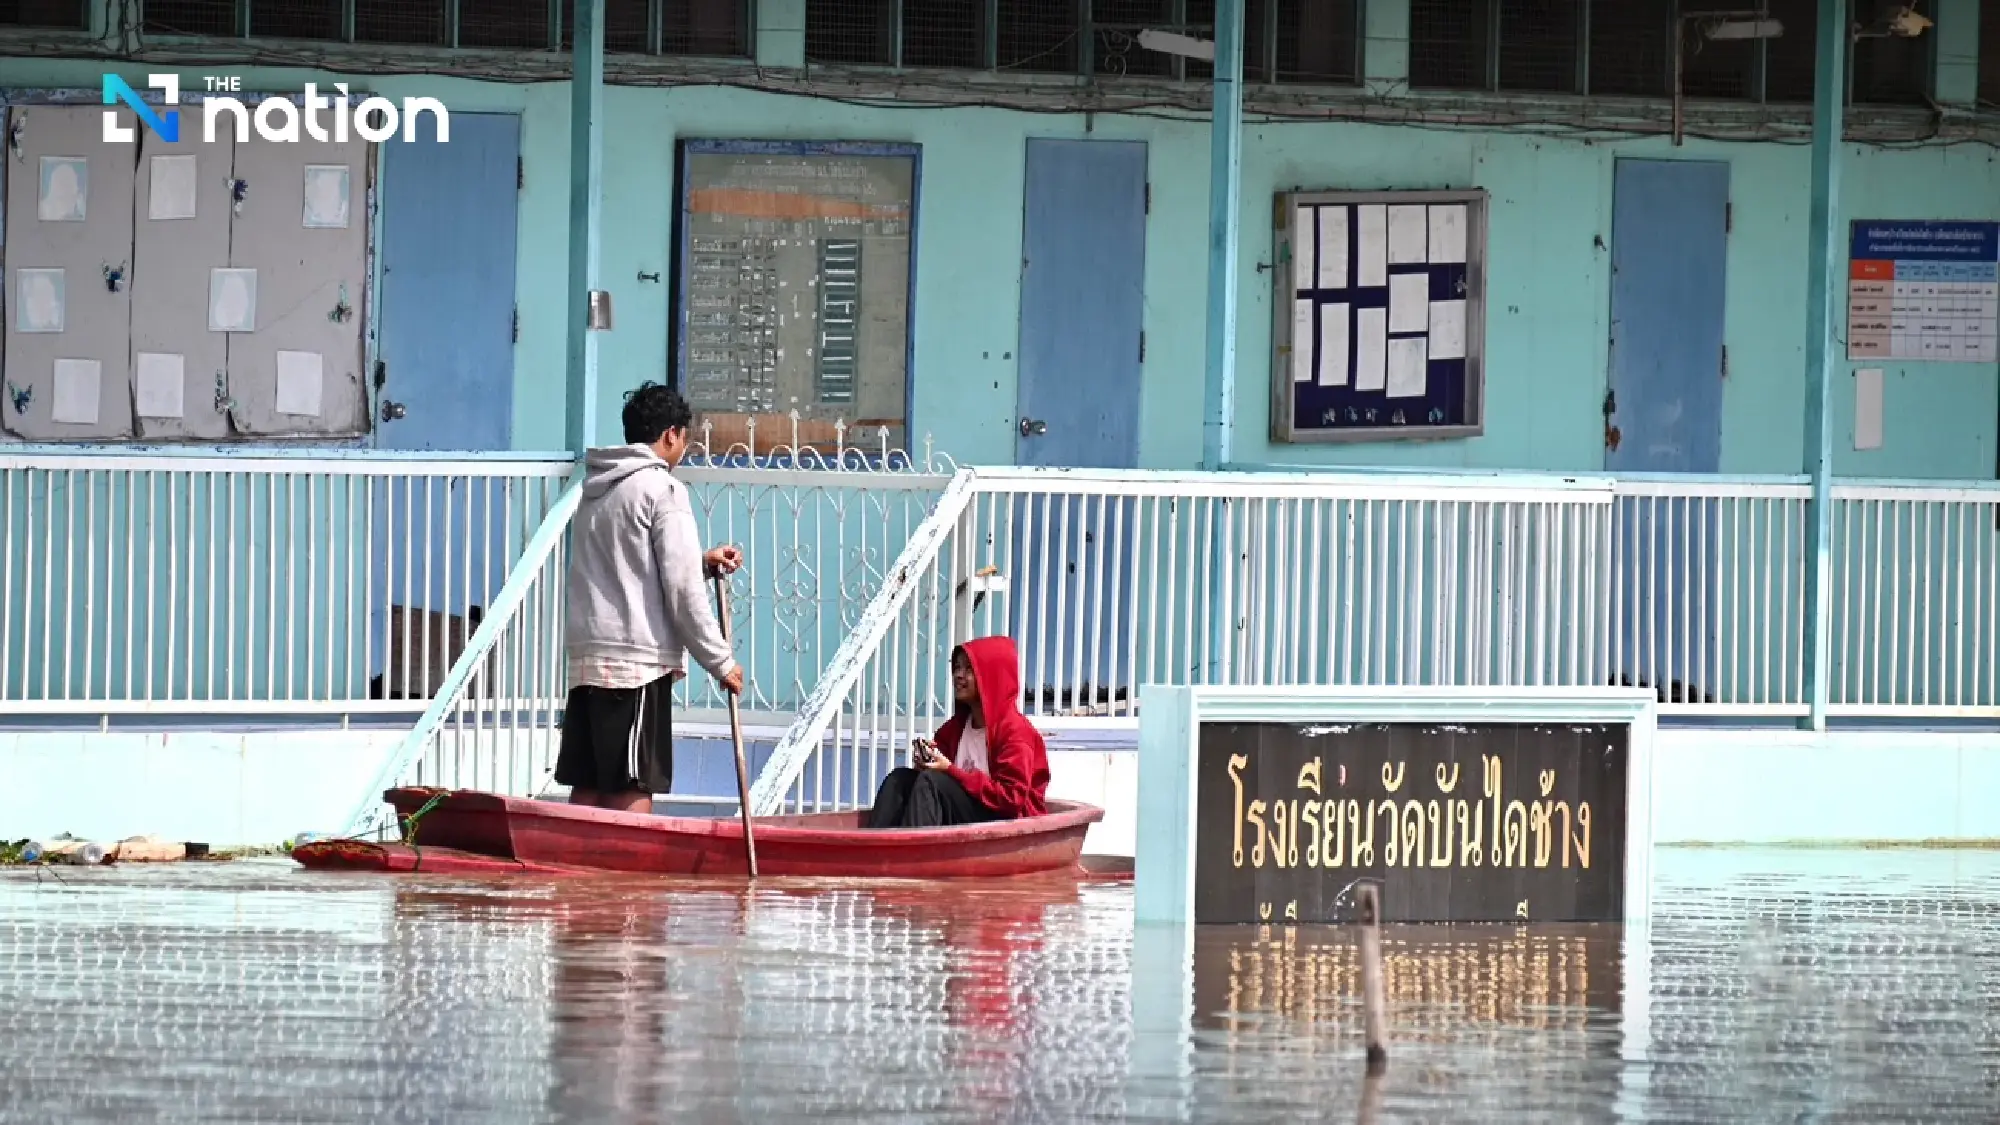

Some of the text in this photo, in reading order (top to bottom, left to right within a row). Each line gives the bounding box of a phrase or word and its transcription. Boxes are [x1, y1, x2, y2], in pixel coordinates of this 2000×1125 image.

[1227, 753, 1593, 869] โรงเรียนวัดบันไดช้าง
